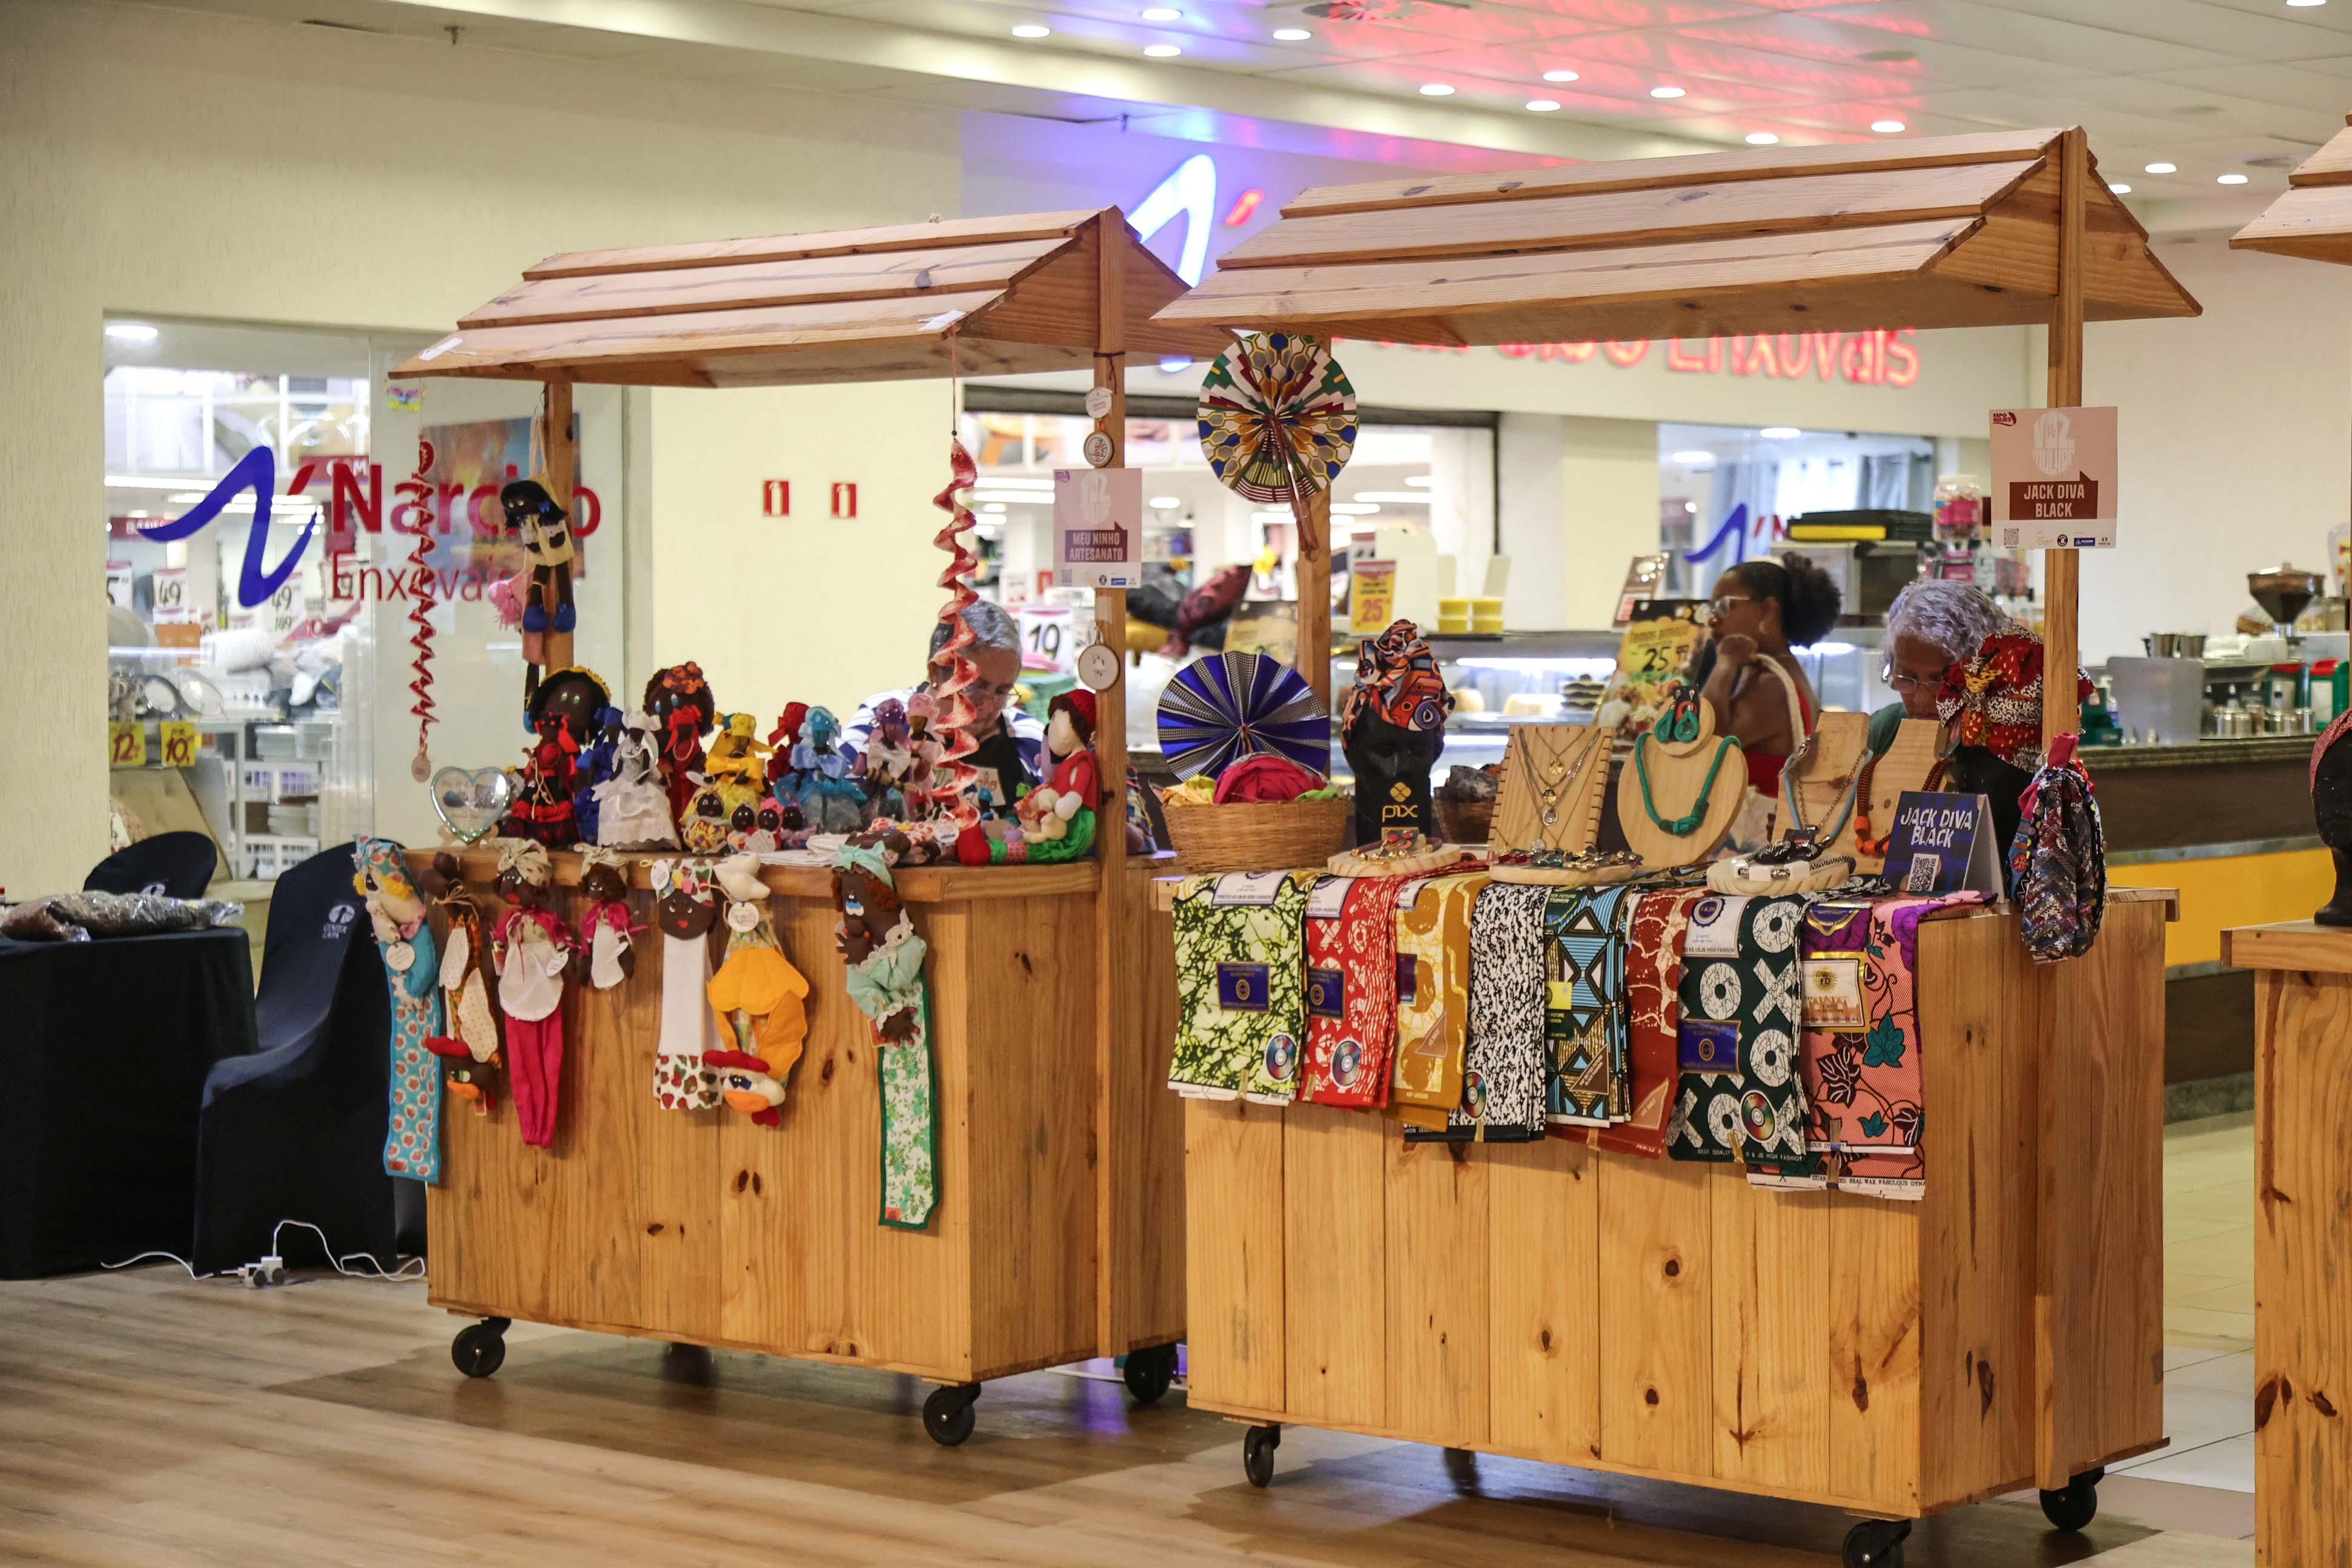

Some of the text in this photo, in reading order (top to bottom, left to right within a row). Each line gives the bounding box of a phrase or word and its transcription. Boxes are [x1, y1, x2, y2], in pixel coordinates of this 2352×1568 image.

[2024, 484, 2085, 500] JACK DIVA
[2035, 503, 2072, 518] BLACK
[1073, 532, 1119, 545] MEU NINHO
[1069, 547, 1123, 561] ARTESANATO
[1641, 646, 1671, 672] 25
[1900, 807, 1972, 831] JACK DIVA
[1910, 826, 1954, 848] BLACK
